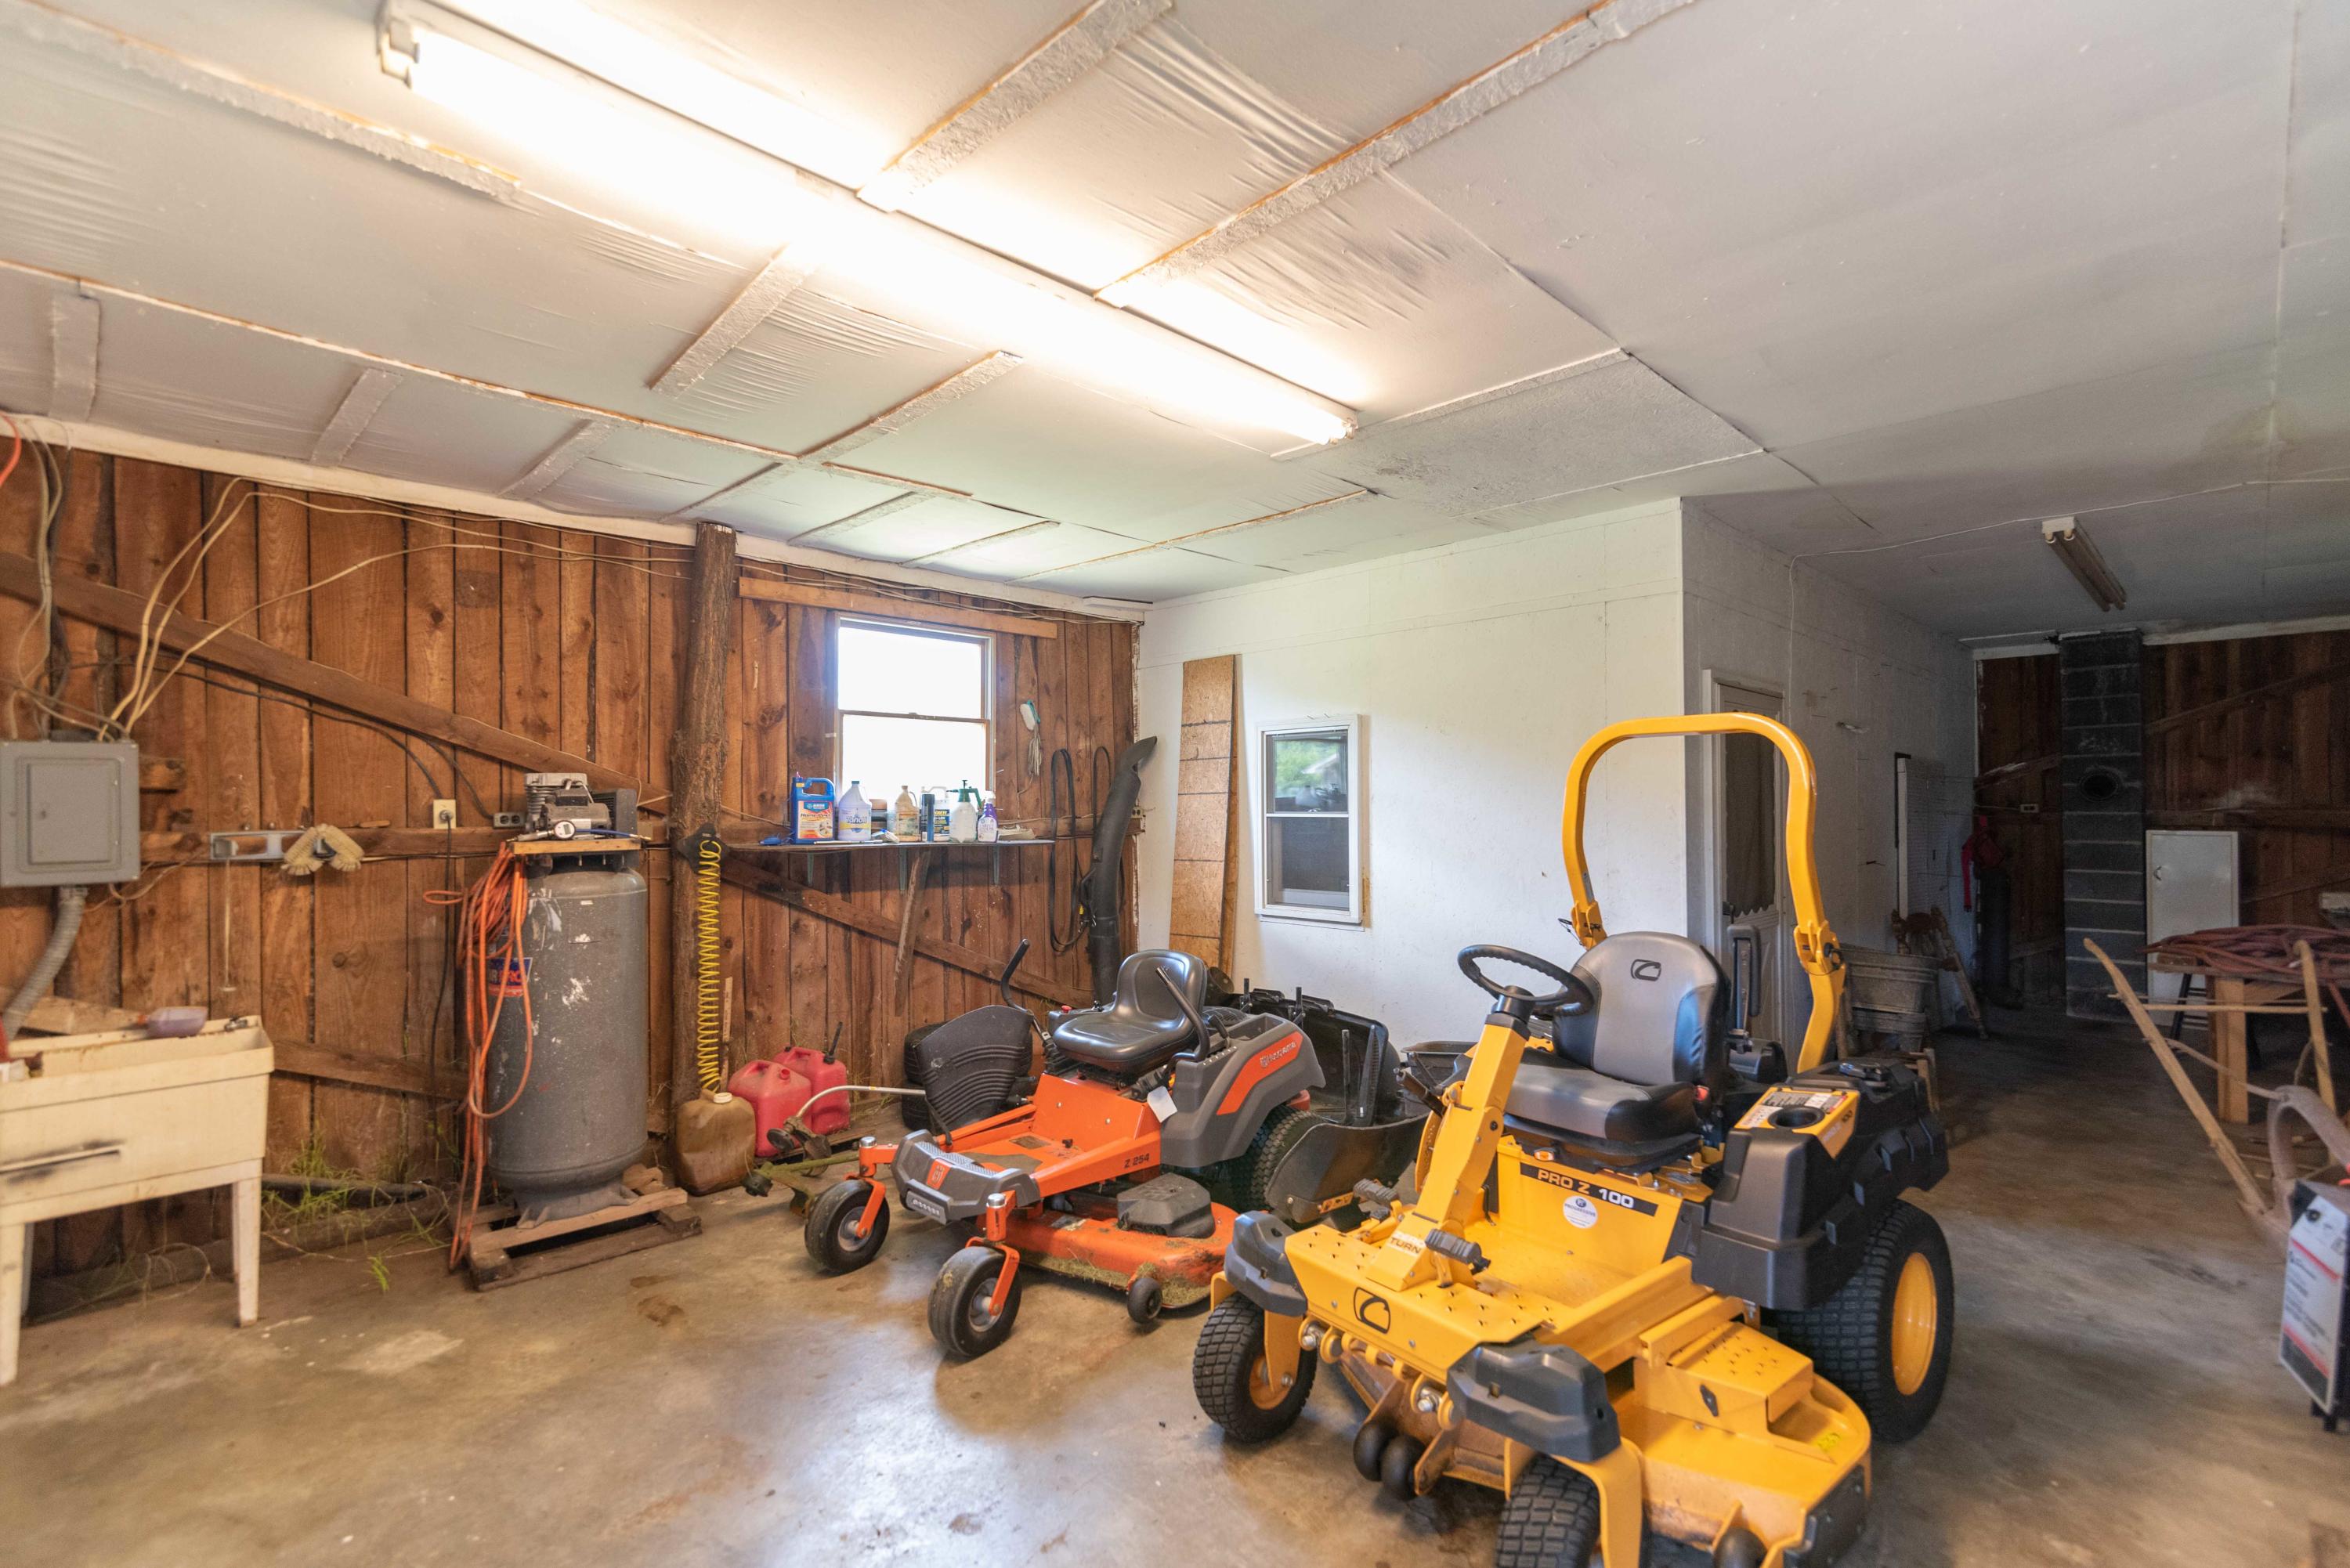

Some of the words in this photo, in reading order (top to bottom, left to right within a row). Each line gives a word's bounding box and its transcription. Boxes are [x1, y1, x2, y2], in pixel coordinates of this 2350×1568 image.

[1123, 1158, 1131, 1169] Z
[1133, 1152, 1150, 1166] 254
[1538, 1169, 1574, 1190] PRO
[1577, 1181, 1590, 1194] Z
[1598, 1188, 1635, 1209] 100
[1390, 1237, 1422, 1254] TURN
